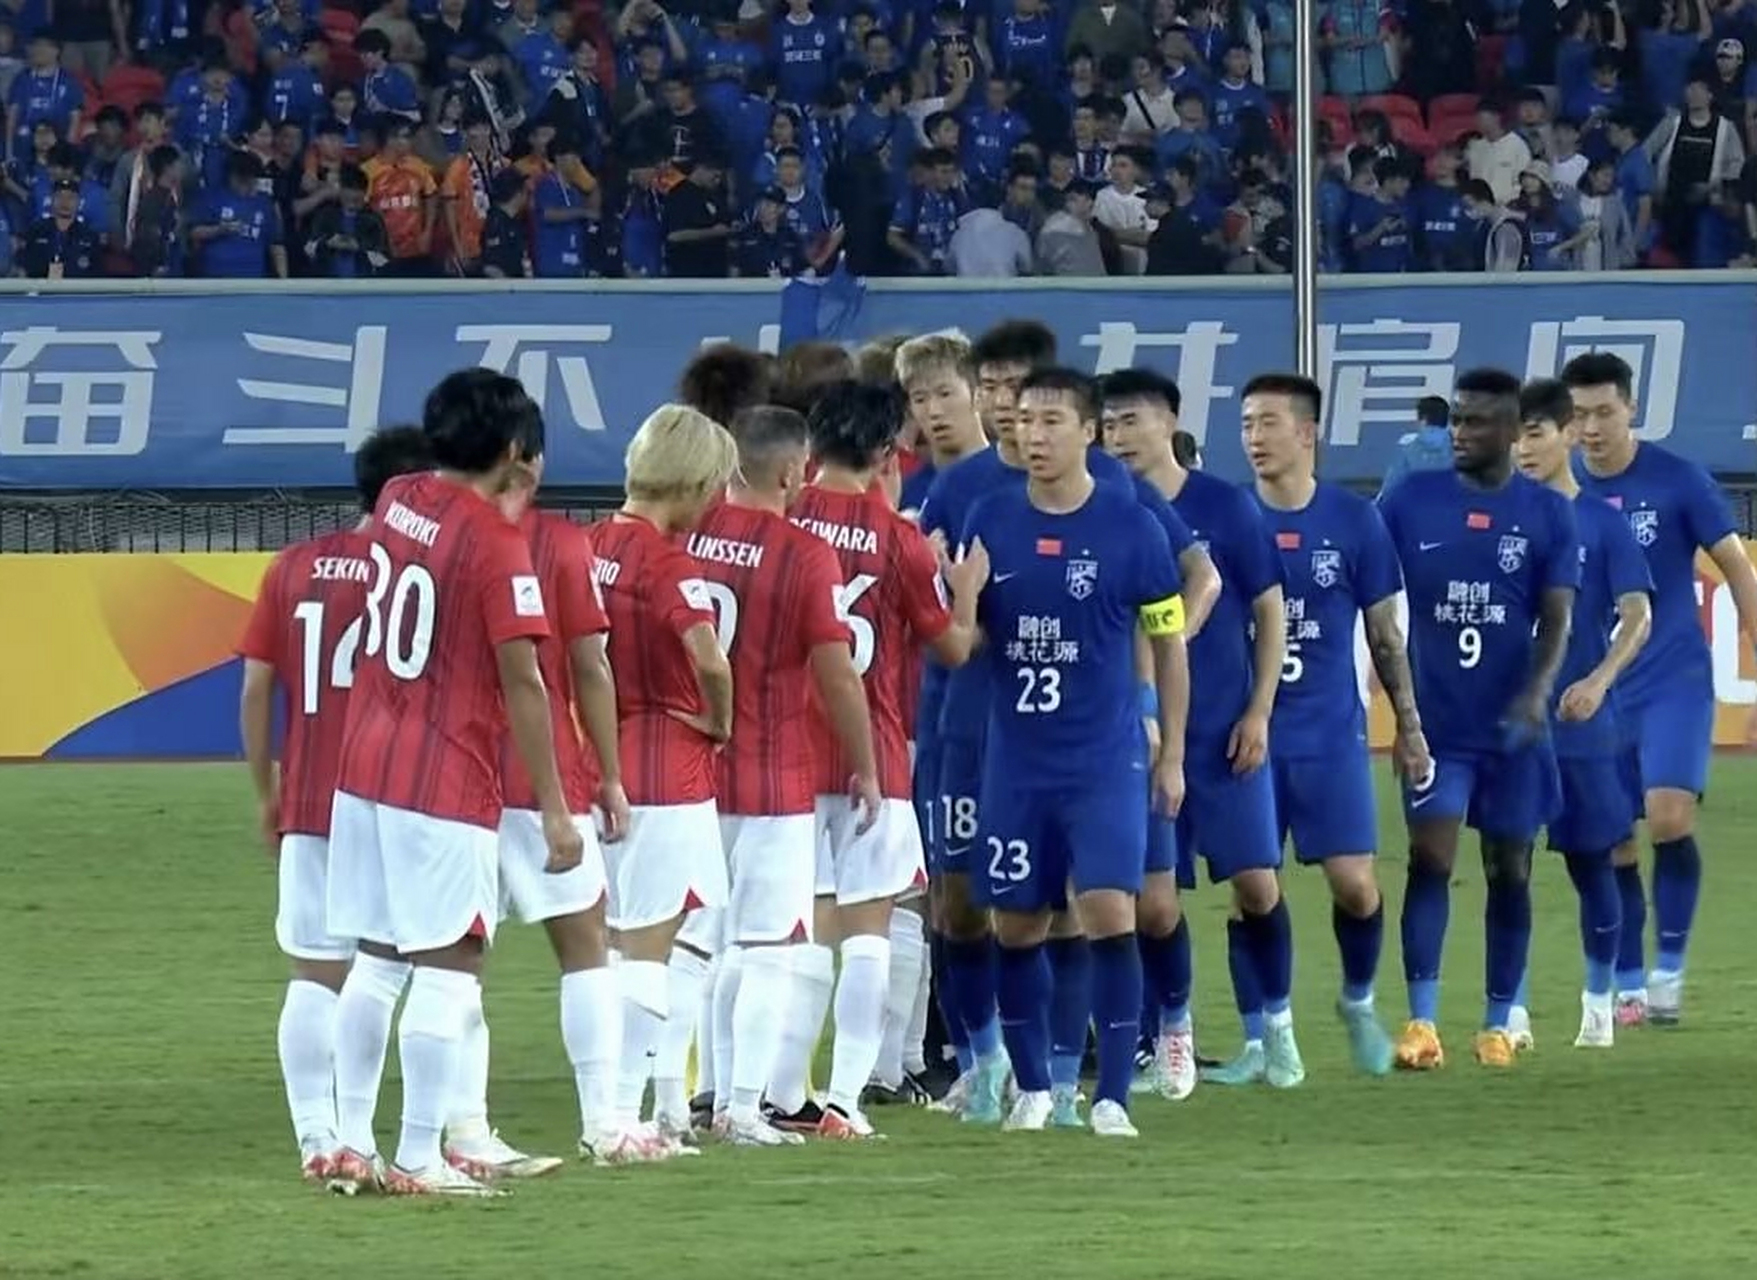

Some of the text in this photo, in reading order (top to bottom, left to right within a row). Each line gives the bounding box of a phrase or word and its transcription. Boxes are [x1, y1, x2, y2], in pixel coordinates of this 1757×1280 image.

[686, 532, 764, 568] LINSSEN
[789, 518, 878, 555] IWARA
[311, 557, 370, 582] SEKIN
[1459, 627, 1482, 668] 9
[1016, 667, 1061, 713] 23
[941, 795, 978, 839] 18
[987, 836, 1031, 881] 23
